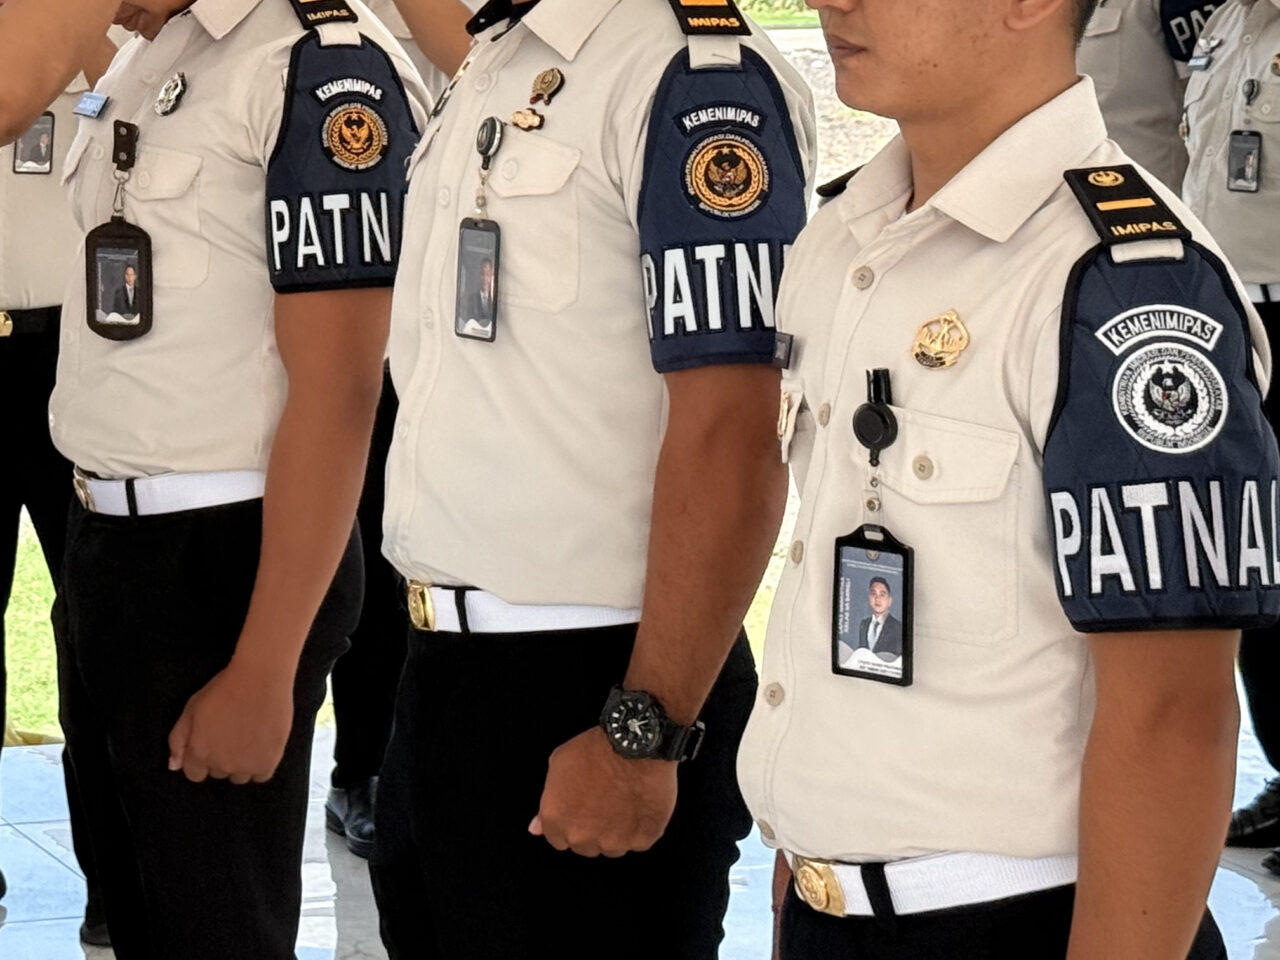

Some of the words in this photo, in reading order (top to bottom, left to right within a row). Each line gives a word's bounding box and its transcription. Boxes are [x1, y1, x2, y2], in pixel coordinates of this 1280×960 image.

[306, 9, 350, 21] IMIPAS
[687, 17, 740, 27] IMIPAS
[315, 78, 382, 101] KEMENIMIPAS
[682, 107, 760, 132] KEMENIMIPAS
[270, 192, 408, 270] PATN
[1110, 221, 1177, 236] IMIPAS
[640, 243, 794, 339] PATN
[1107, 311, 1213, 345] KEMENIMIPAS
